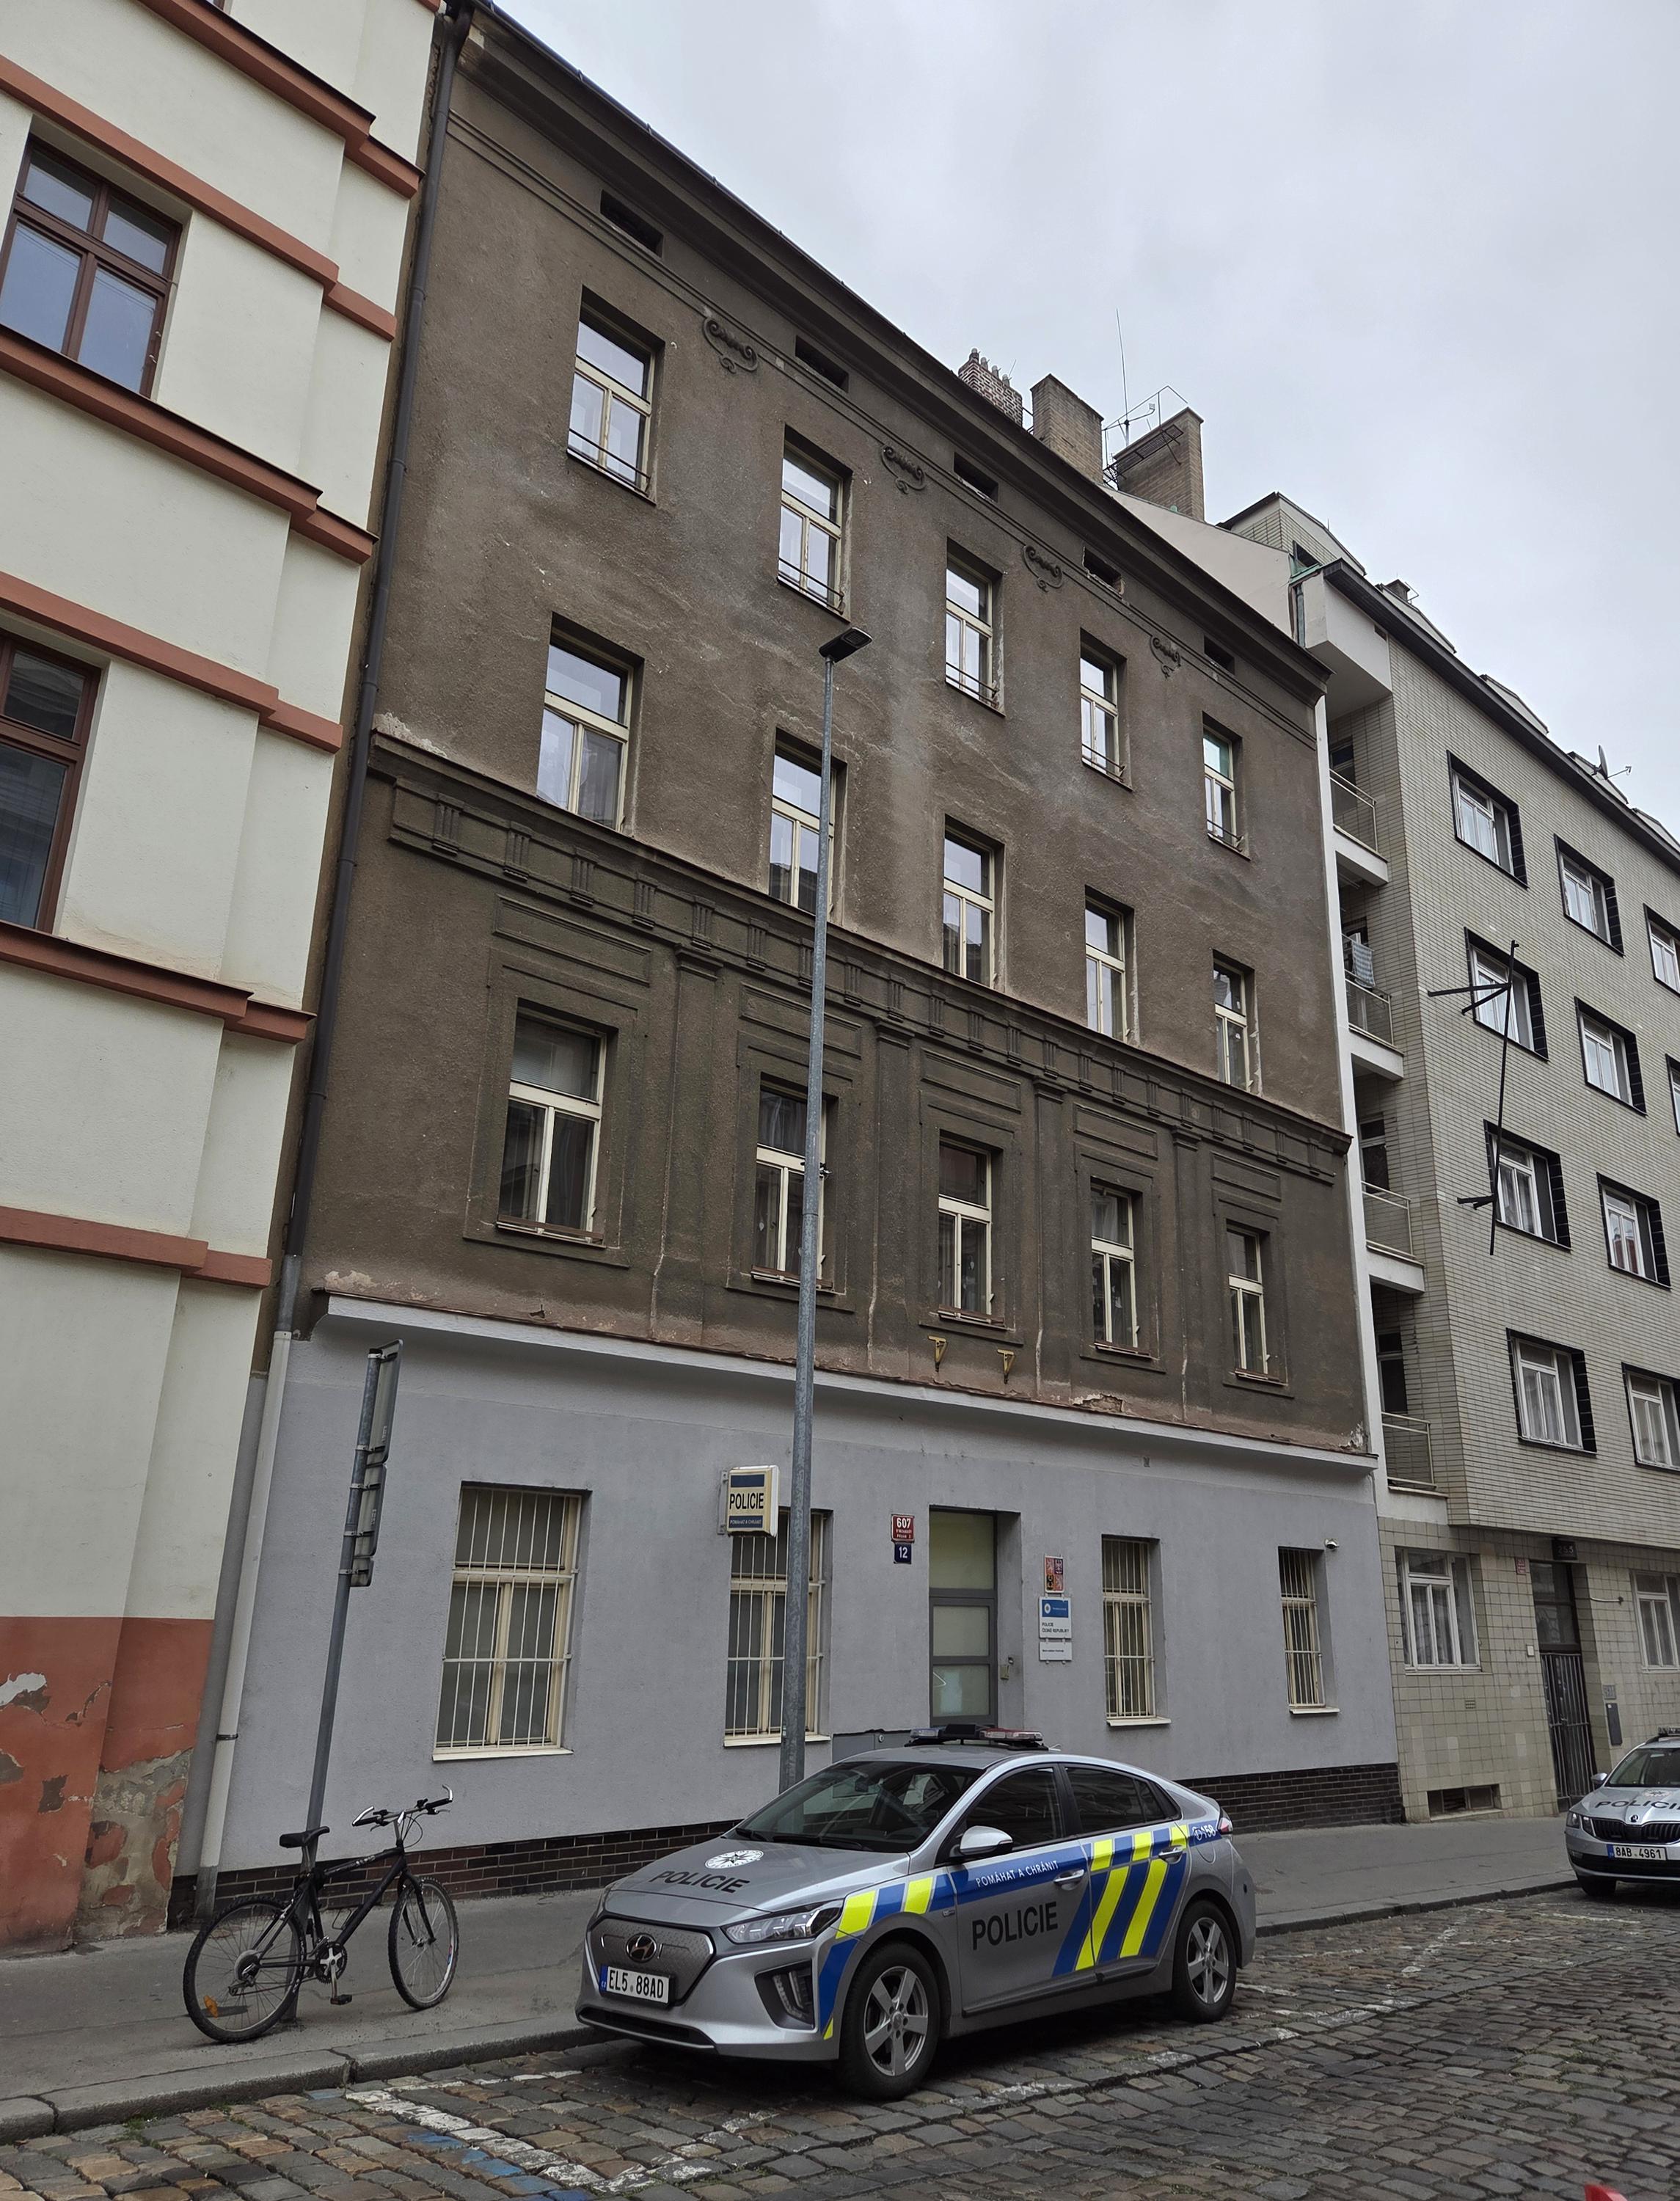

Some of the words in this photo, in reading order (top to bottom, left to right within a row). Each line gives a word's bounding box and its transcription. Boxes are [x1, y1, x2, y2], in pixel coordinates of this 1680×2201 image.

[729, 1492, 764, 1510] POLICIE
[896, 1517, 911, 1528] 607
[899, 1546, 908, 1559] 12
[1595, 1800, 1680, 1811] POLICI
[1201, 1824, 1216, 1839] 158
[1615, 1847, 1632, 1857] 8AB
[1639, 1848, 1662, 1859] 4961
[649, 1871, 750, 1894] POLICIE
[976, 1869, 1016, 1888] POMÁHAT
[1018, 1869, 1025, 1877] A
[1026, 1861, 1059, 1876] CHRÁNIT
[972, 1901, 1058, 1950] POLICIE
[609, 1969, 628, 1992] EL5
[636, 1975, 663, 1999] 88AD
